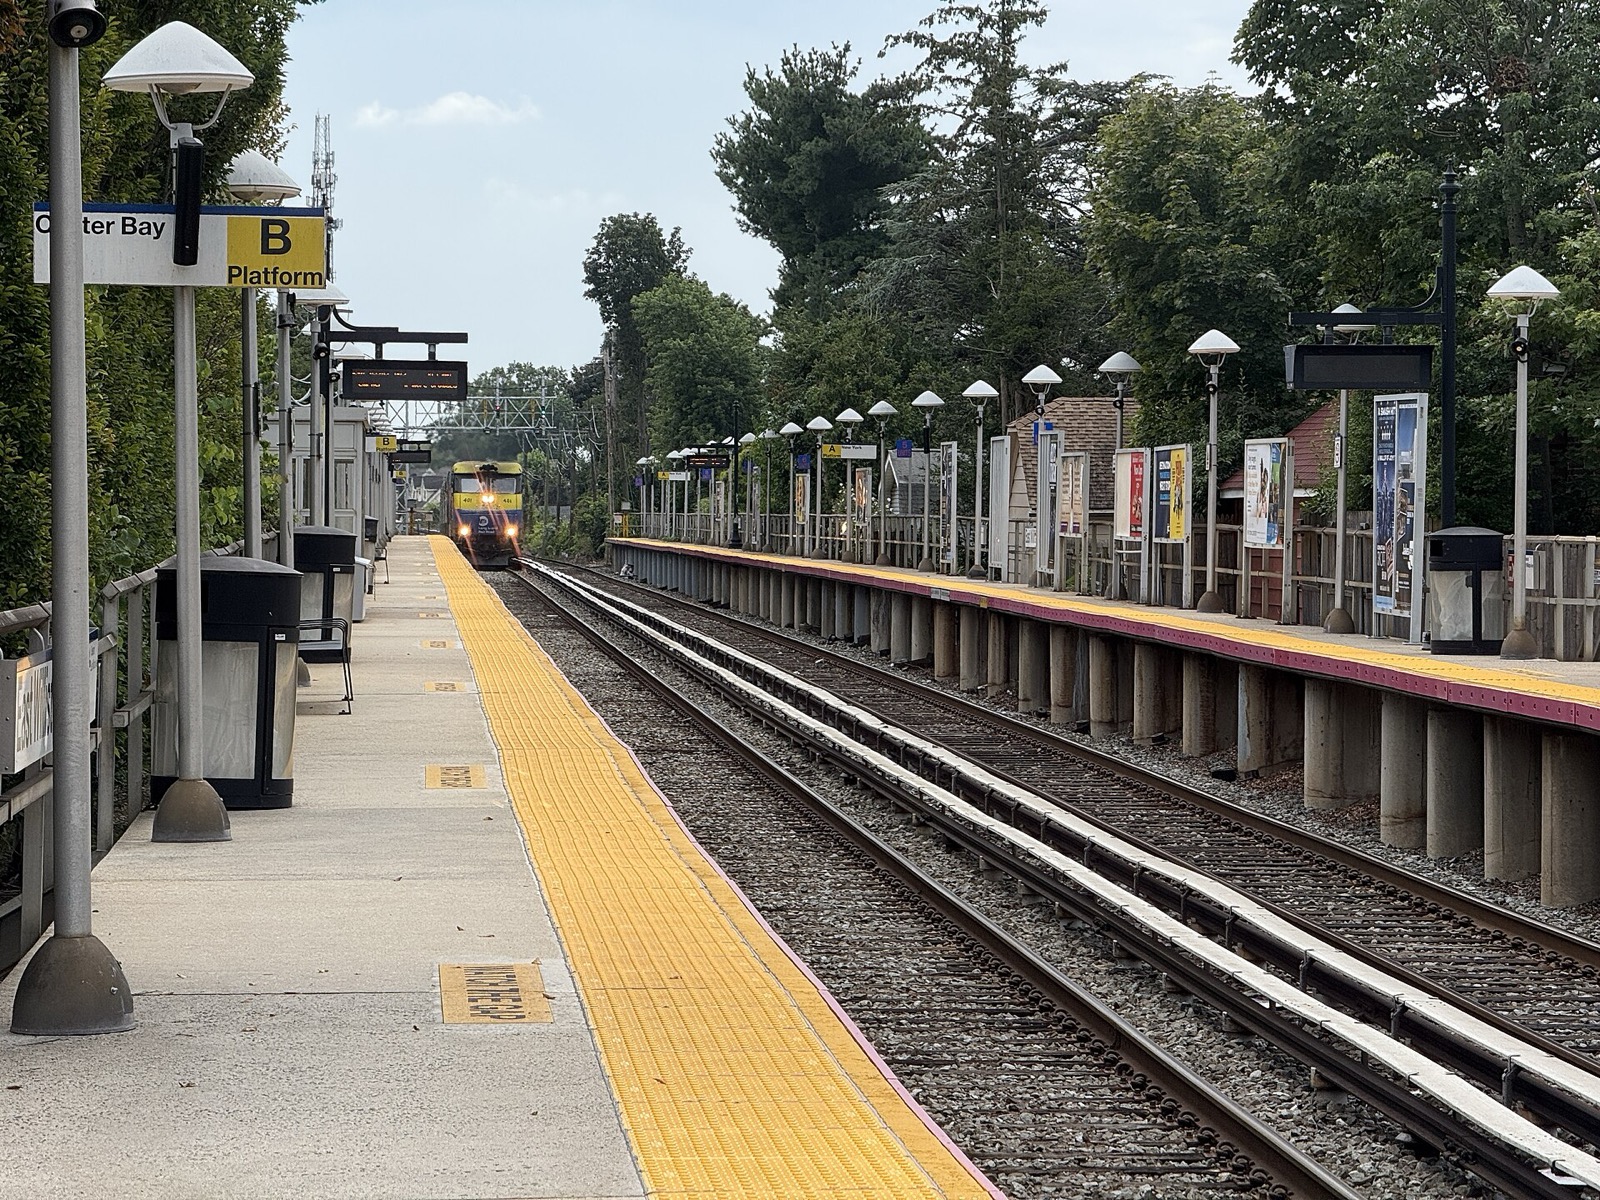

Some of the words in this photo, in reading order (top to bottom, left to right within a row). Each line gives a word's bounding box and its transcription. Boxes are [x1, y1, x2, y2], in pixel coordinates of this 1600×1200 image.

[35, 214, 115, 235] Oter
[121, 216, 166, 240] Bay
[260, 218, 292, 255] B
[227, 265, 323, 286] Platform
[382, 437, 390, 446] B
[828, 444, 836, 453] A
[466, 987, 523, 1003] THE
[469, 1004, 526, 1020] GAP
